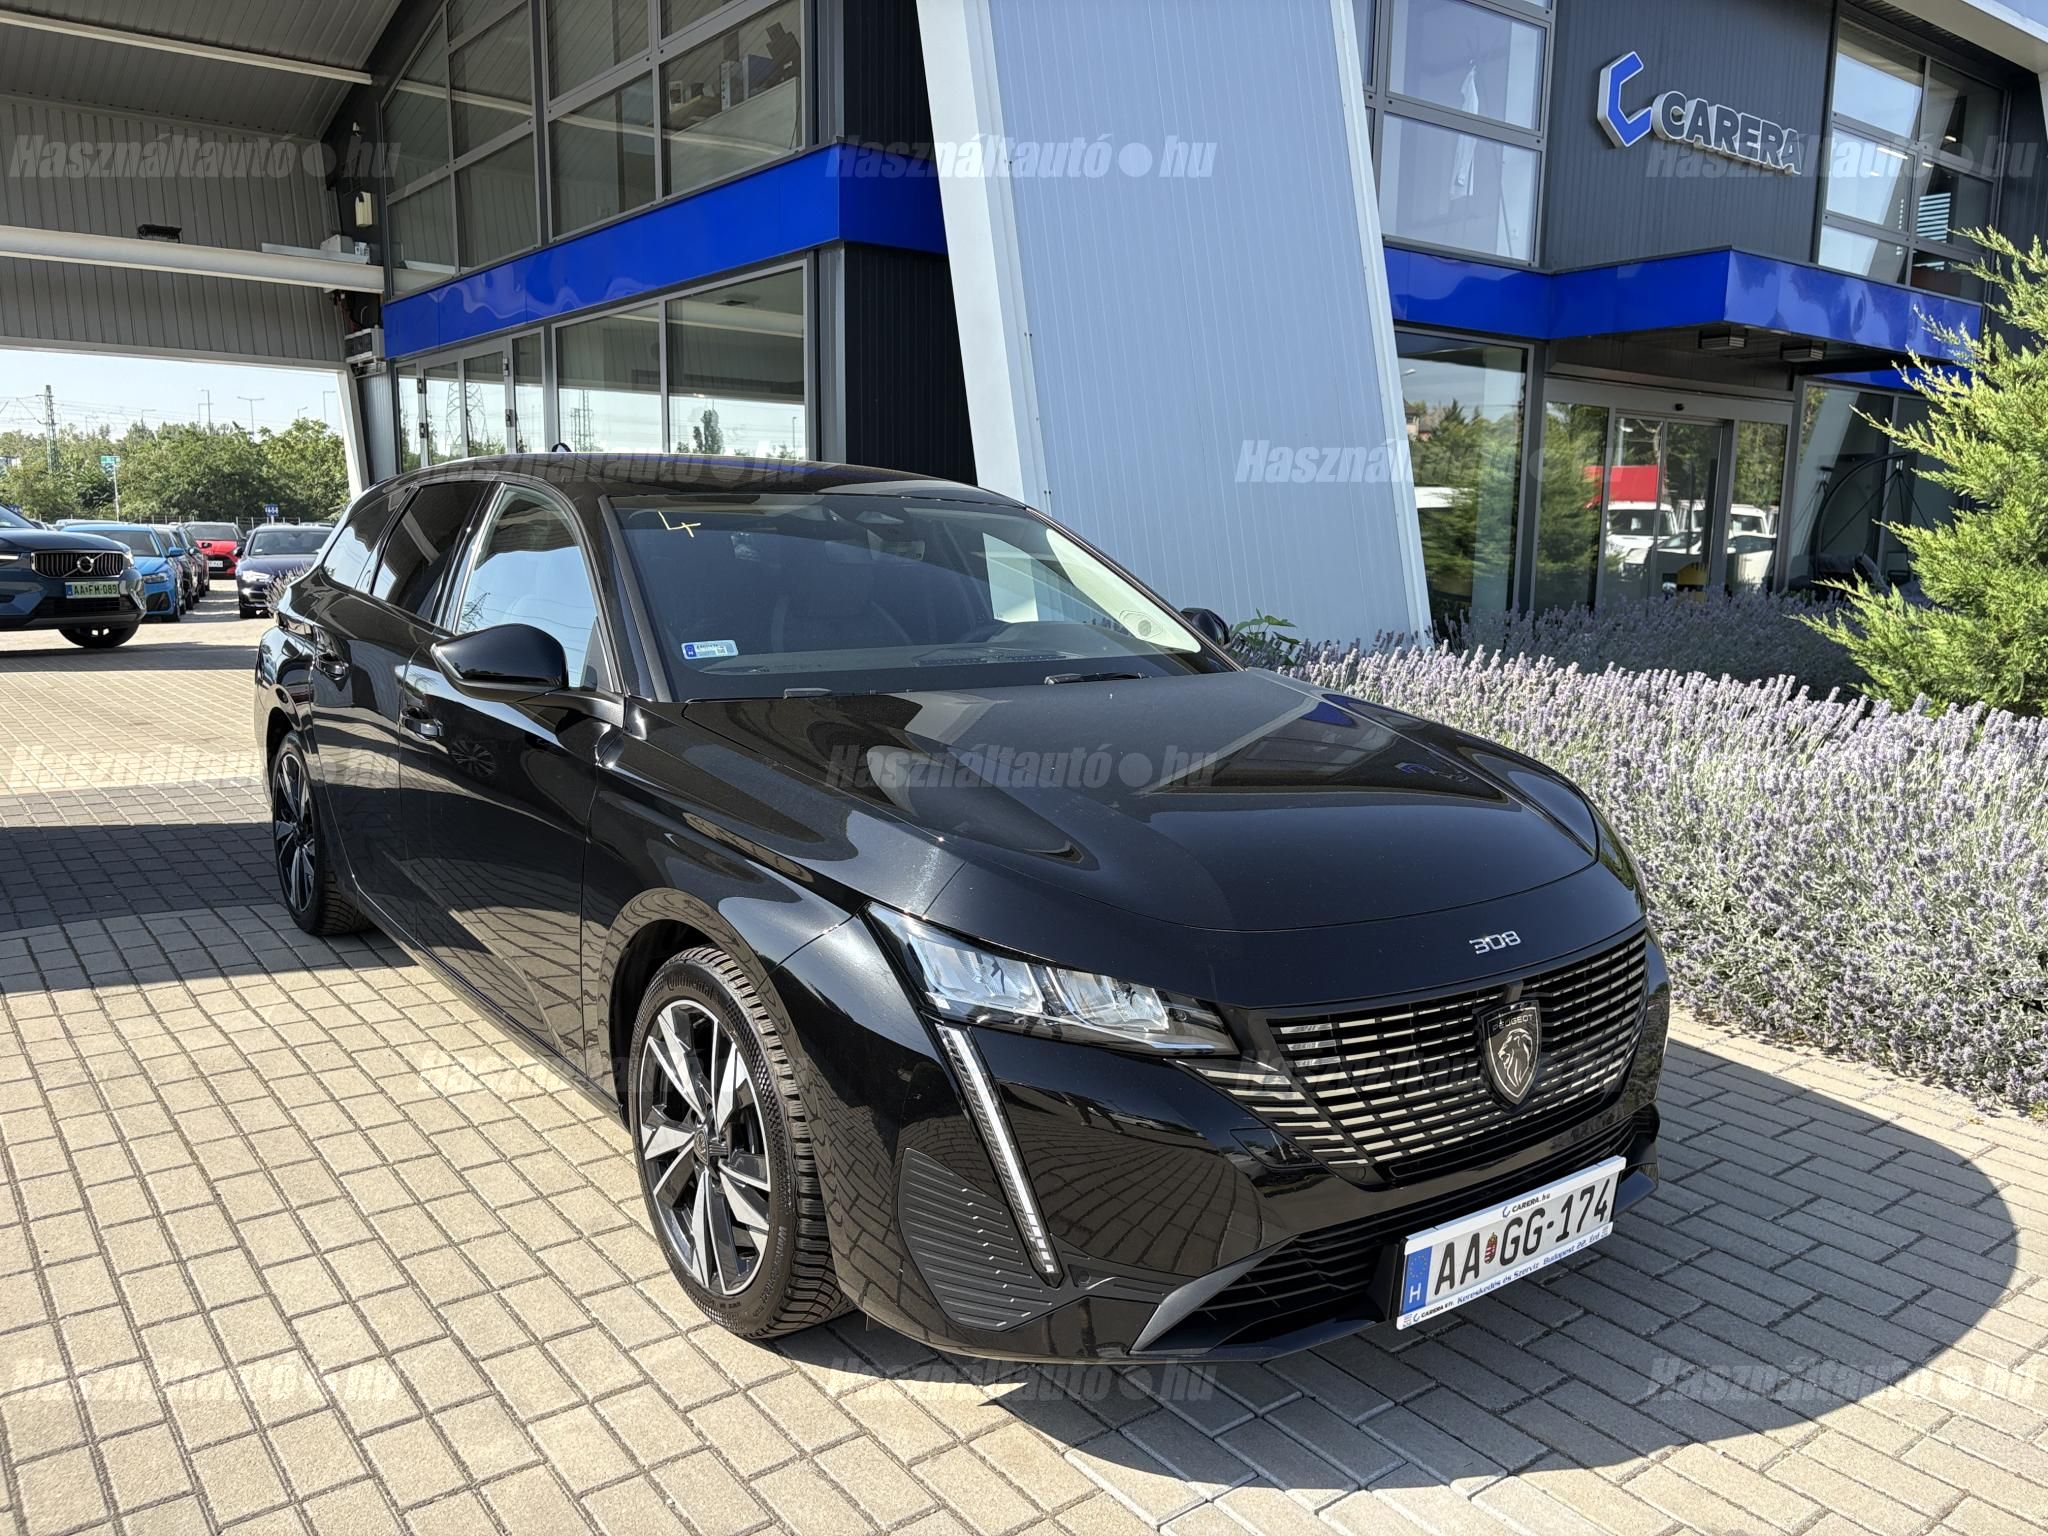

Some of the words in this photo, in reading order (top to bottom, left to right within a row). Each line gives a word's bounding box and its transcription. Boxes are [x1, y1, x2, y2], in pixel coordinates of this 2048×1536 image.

[1652, 90, 1802, 176] CARERA
[1468, 930, 1522, 955] 308
[1492, 1014, 1534, 1032] PEUGEOT
[1434, 1232, 1480, 1296] AA
[1500, 1178, 1610, 1267] GG-174
[1409, 1282, 1422, 1304] H
